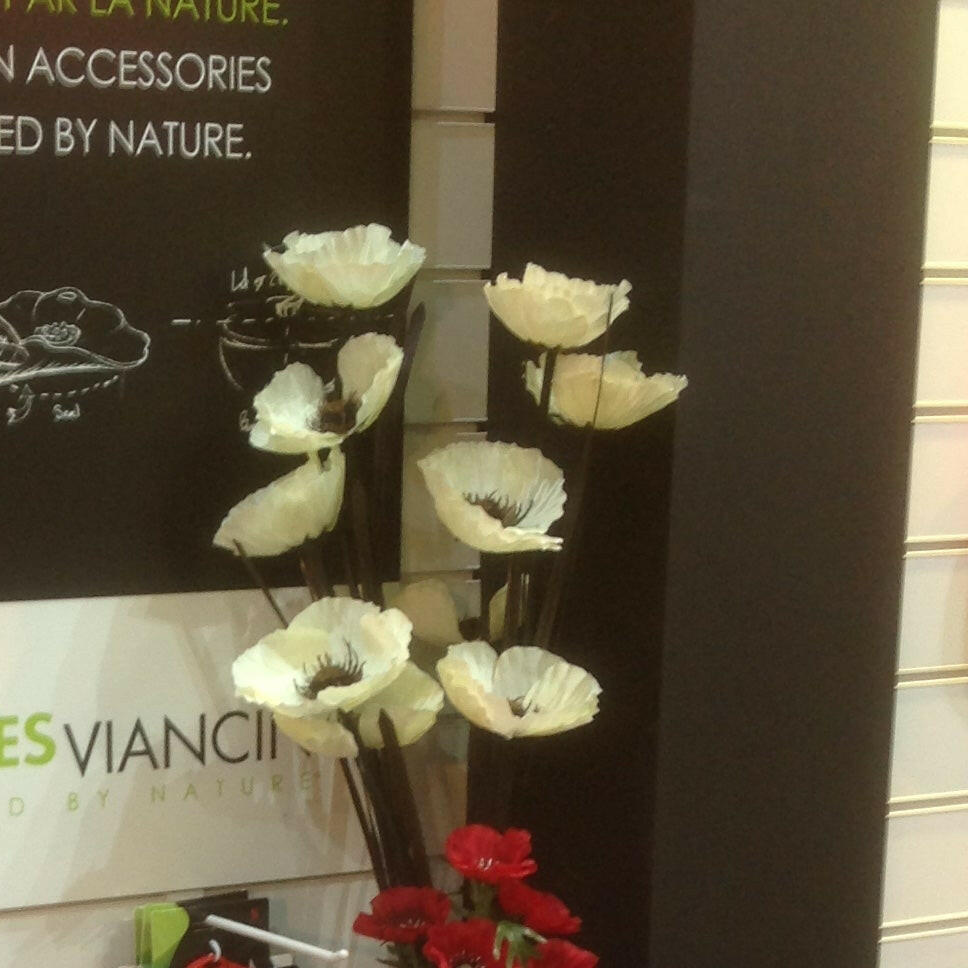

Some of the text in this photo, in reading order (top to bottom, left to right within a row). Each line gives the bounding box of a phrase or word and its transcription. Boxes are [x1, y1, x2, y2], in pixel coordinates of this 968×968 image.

[26, 47, 272, 93] ACCESSORIES
[54, 117, 97, 157] BY
[108, 121, 253, 159] NATURE.
[68, 787, 110, 812] BY
[151, 771, 314, 803] NATURE
